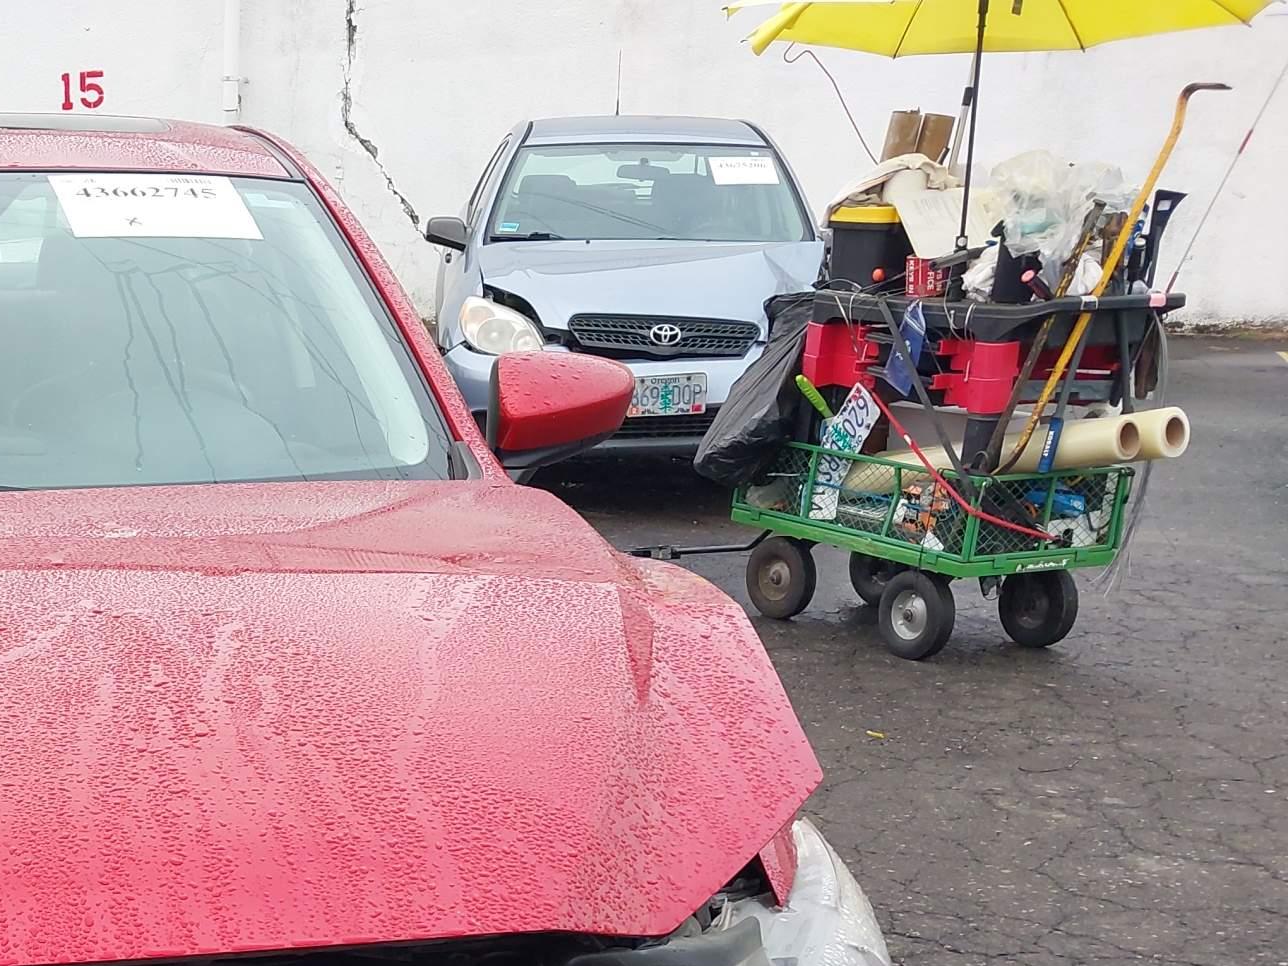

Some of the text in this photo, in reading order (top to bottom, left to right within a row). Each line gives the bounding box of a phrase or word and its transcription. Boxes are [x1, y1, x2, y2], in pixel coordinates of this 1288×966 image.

[61, 70, 104, 110] 15
[76, 186, 217, 199] 43662745
[926, 267, 935, 291] FICE
[650, 376, 680, 387] Oregon
[842, 396, 869, 438] 620
